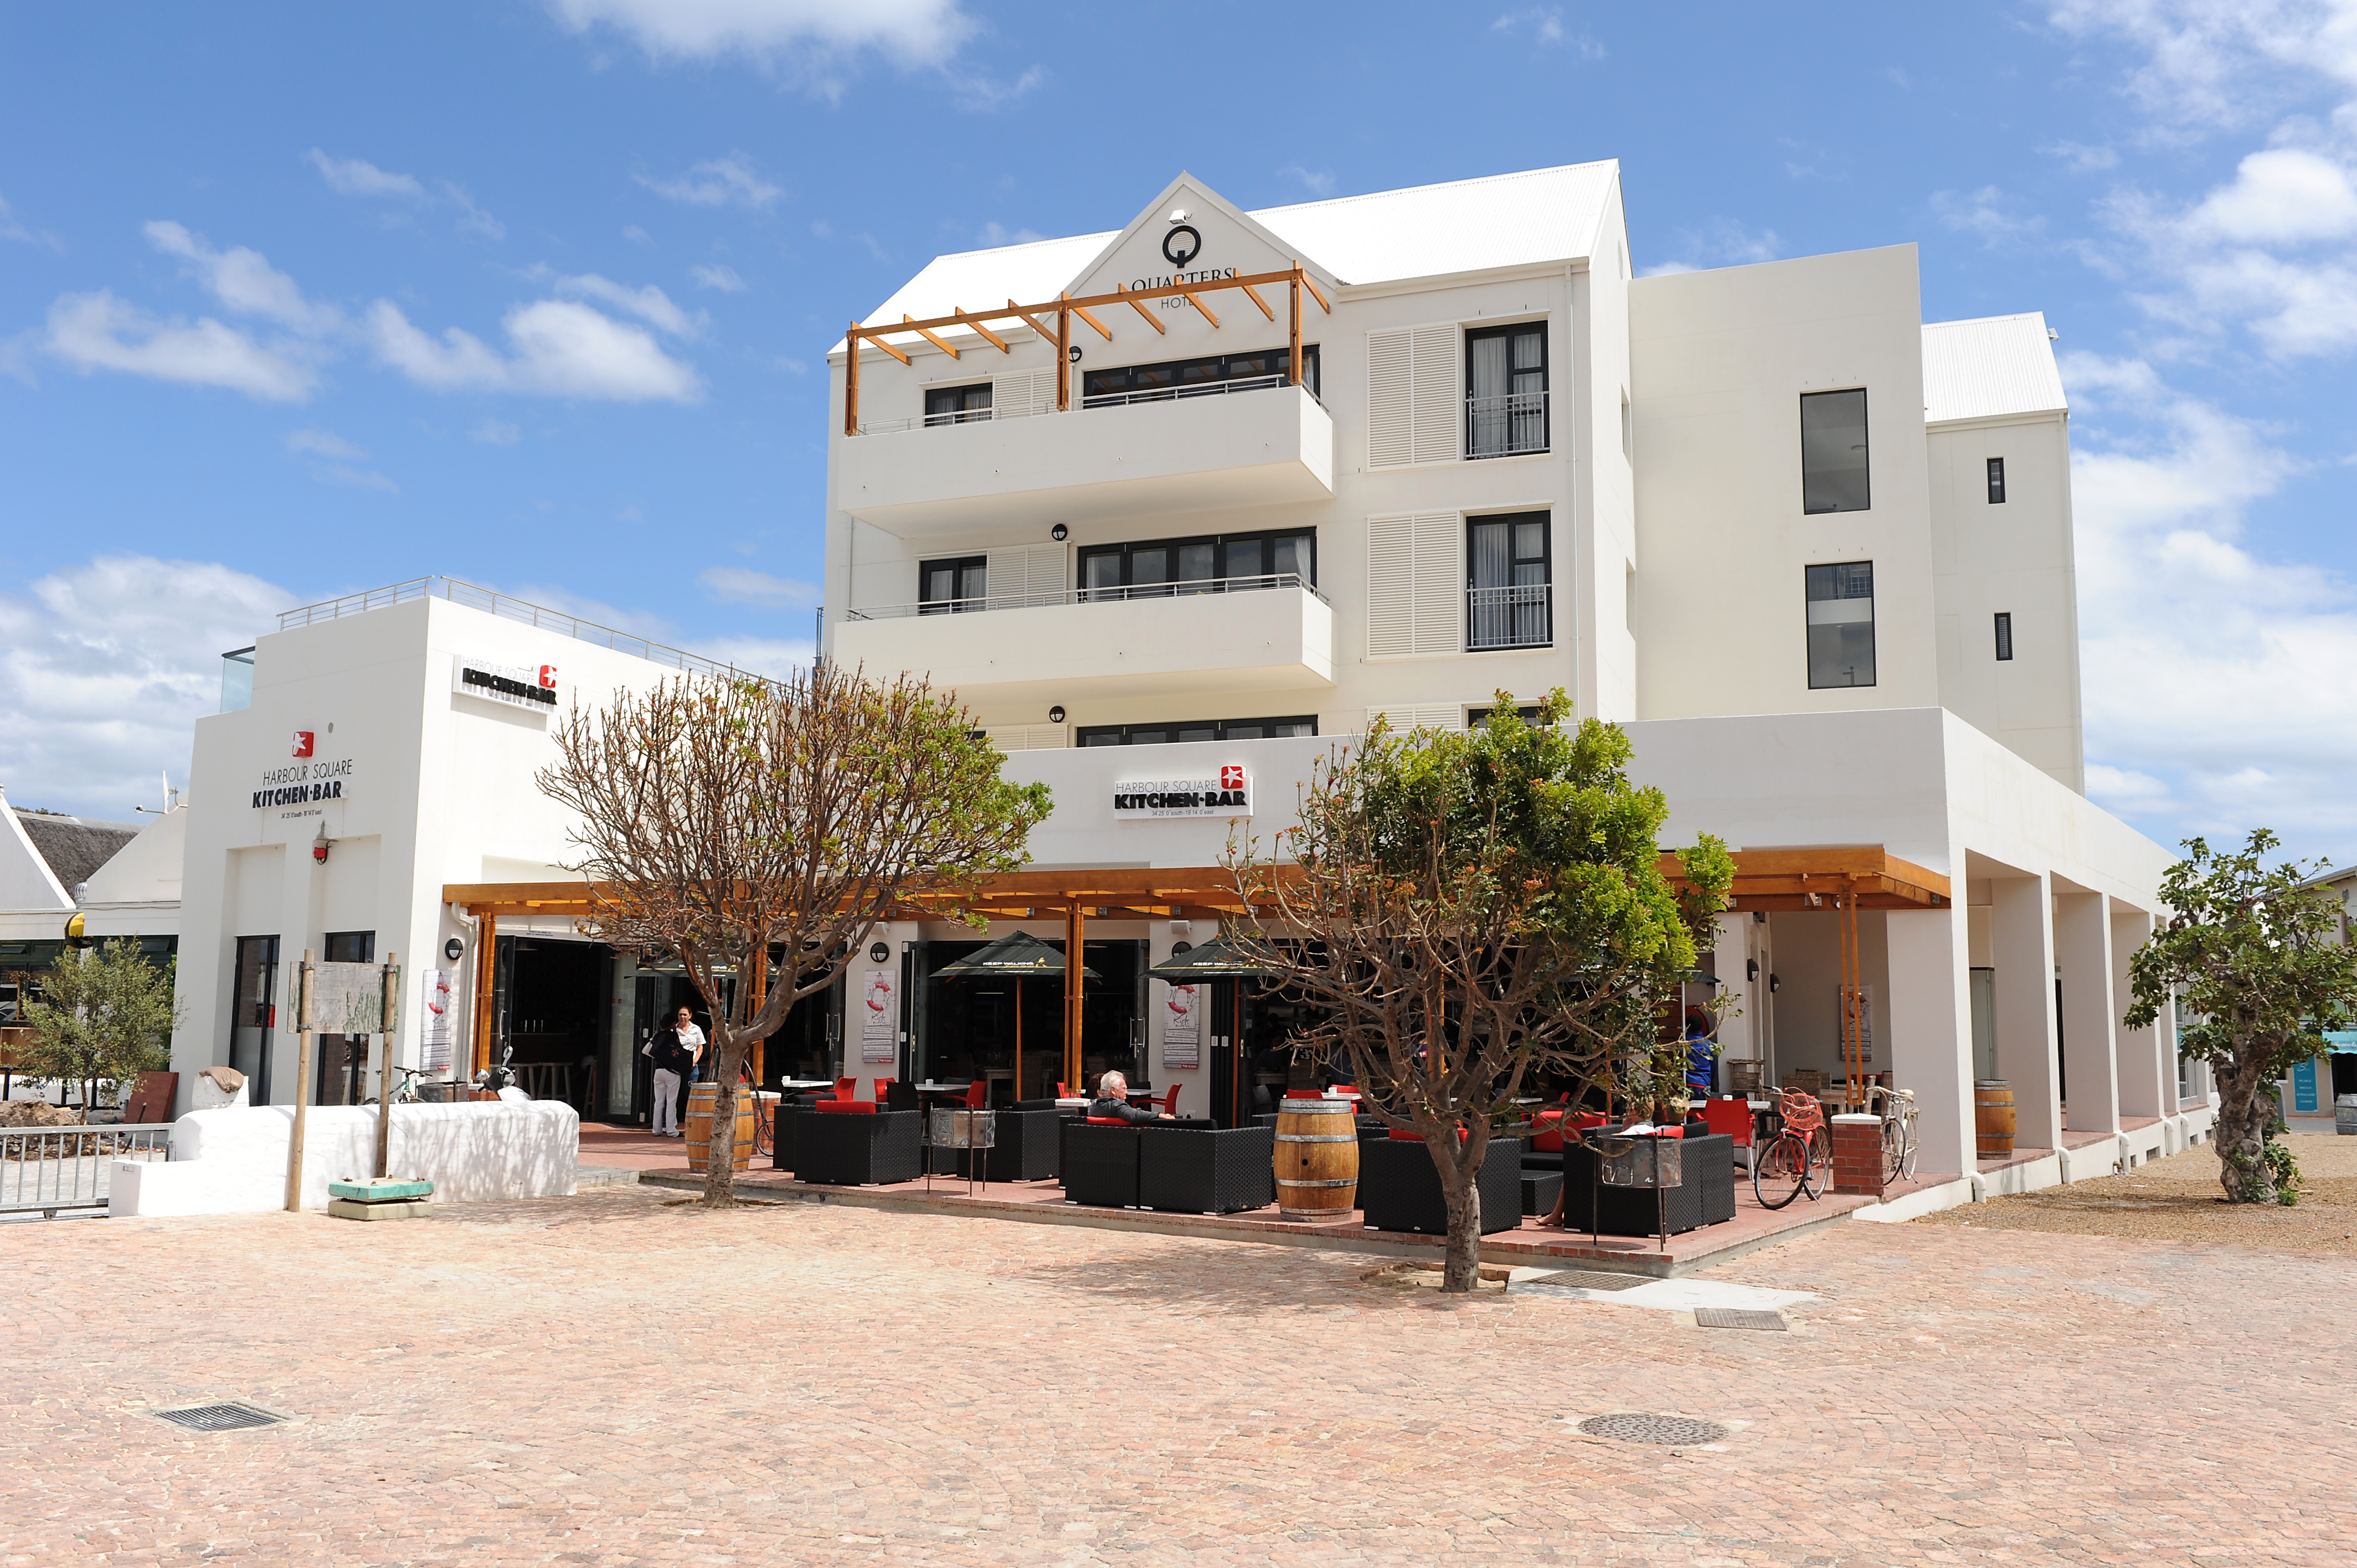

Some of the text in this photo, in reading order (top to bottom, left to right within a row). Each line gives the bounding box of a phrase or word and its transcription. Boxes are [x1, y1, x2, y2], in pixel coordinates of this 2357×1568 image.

[1162, 225, 1202, 269] Q
[462, 656, 536, 685] HARBOUR SQUARE
[263, 759, 352, 786] HARBOUR SQUARE
[1116, 780, 1217, 793] HARBOUR SQUARE
